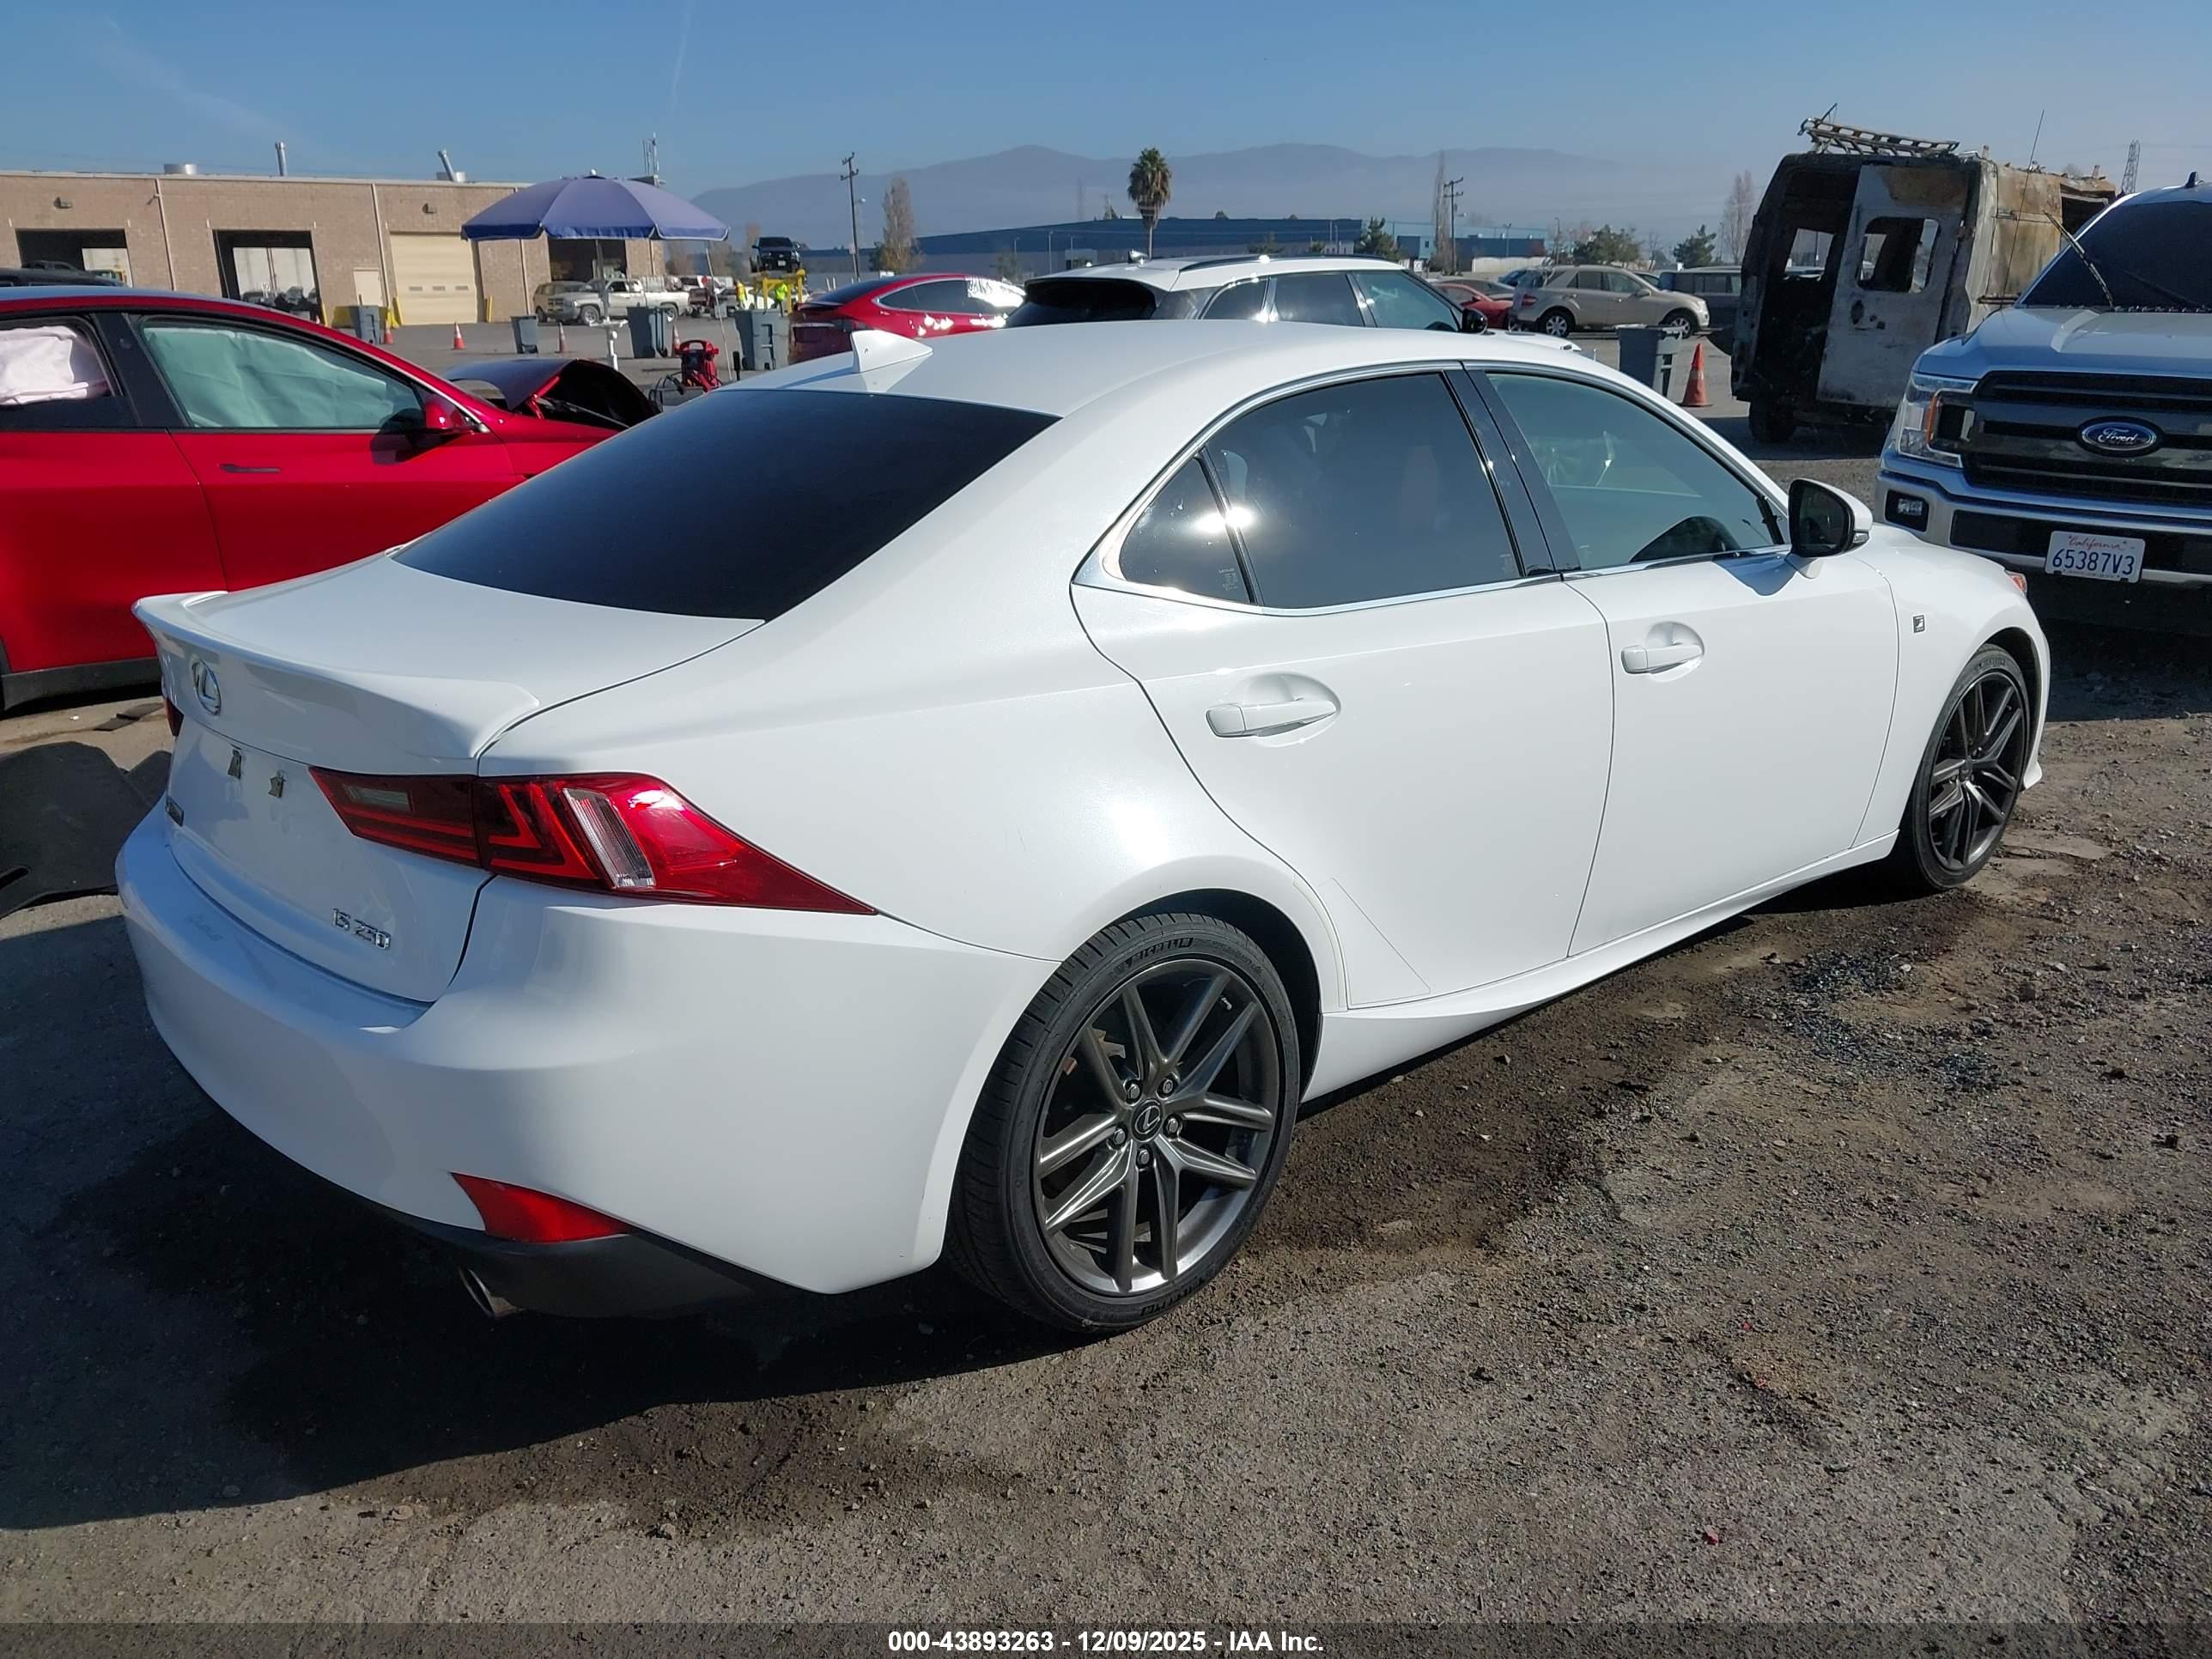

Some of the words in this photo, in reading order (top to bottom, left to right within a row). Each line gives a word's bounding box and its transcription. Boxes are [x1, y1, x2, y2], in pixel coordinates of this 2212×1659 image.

[2097, 427, 2138, 443] Ford
[2069, 535, 2123, 550] California
[2051, 548, 2136, 575] 65387V3
[353, 919, 392, 950] 250
